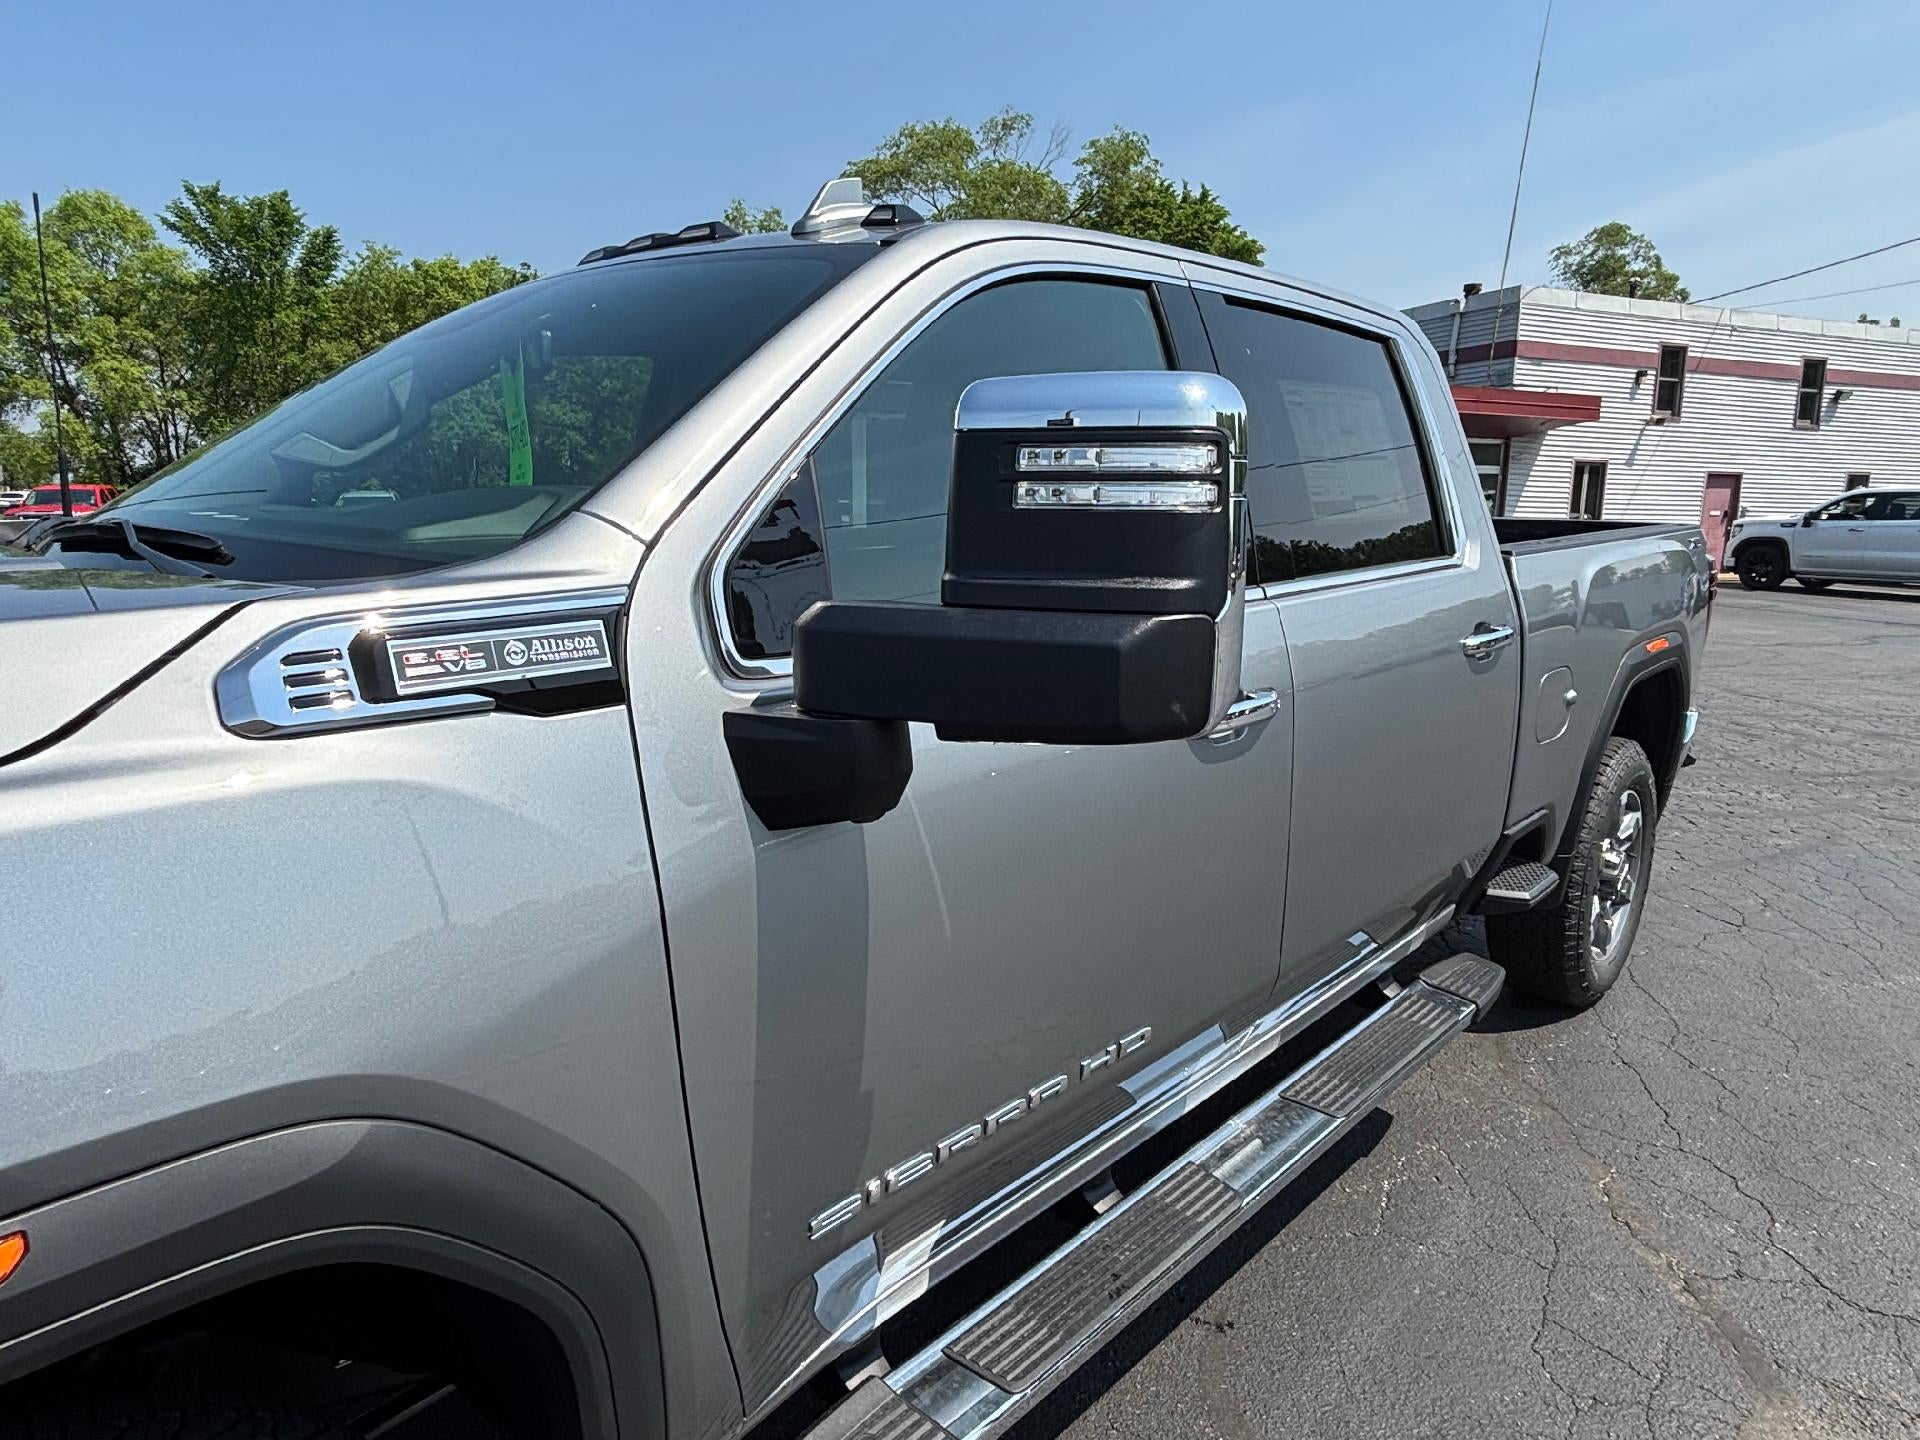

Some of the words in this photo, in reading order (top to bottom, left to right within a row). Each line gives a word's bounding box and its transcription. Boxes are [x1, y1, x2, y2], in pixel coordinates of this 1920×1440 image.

[530, 635, 597, 654] Allison
[529, 648, 600, 662] Transmission
[443, 659, 487, 673] V8
[807, 1074, 1068, 1240] SIERRA
[1079, 1026, 1152, 1081] HD
